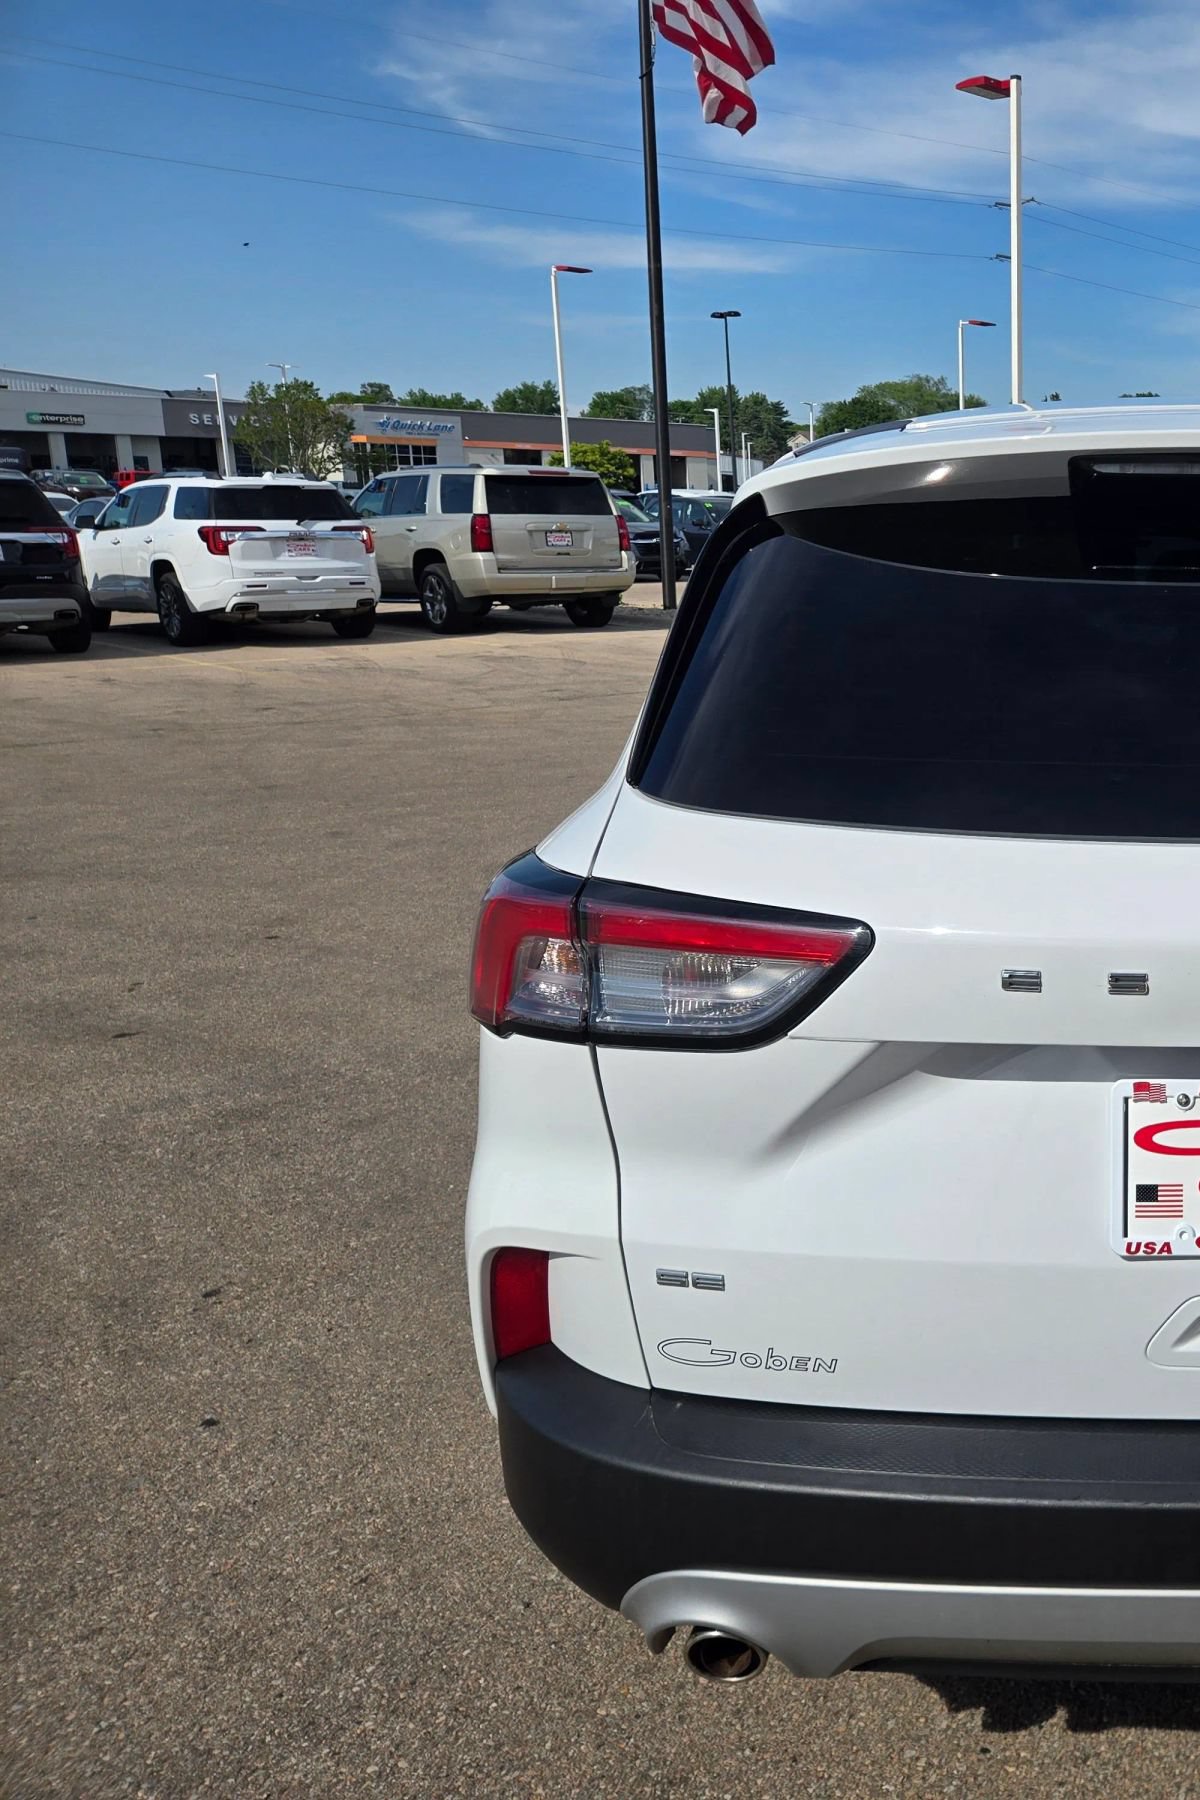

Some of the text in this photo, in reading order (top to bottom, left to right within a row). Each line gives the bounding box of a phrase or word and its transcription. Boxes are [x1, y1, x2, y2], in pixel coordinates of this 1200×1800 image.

[31, 414, 84, 423] enterprise
[391, 419, 455, 433] Quick Lane
[1125, 1241, 1173, 1255] USA
[656, 1268, 726, 1291] SE
